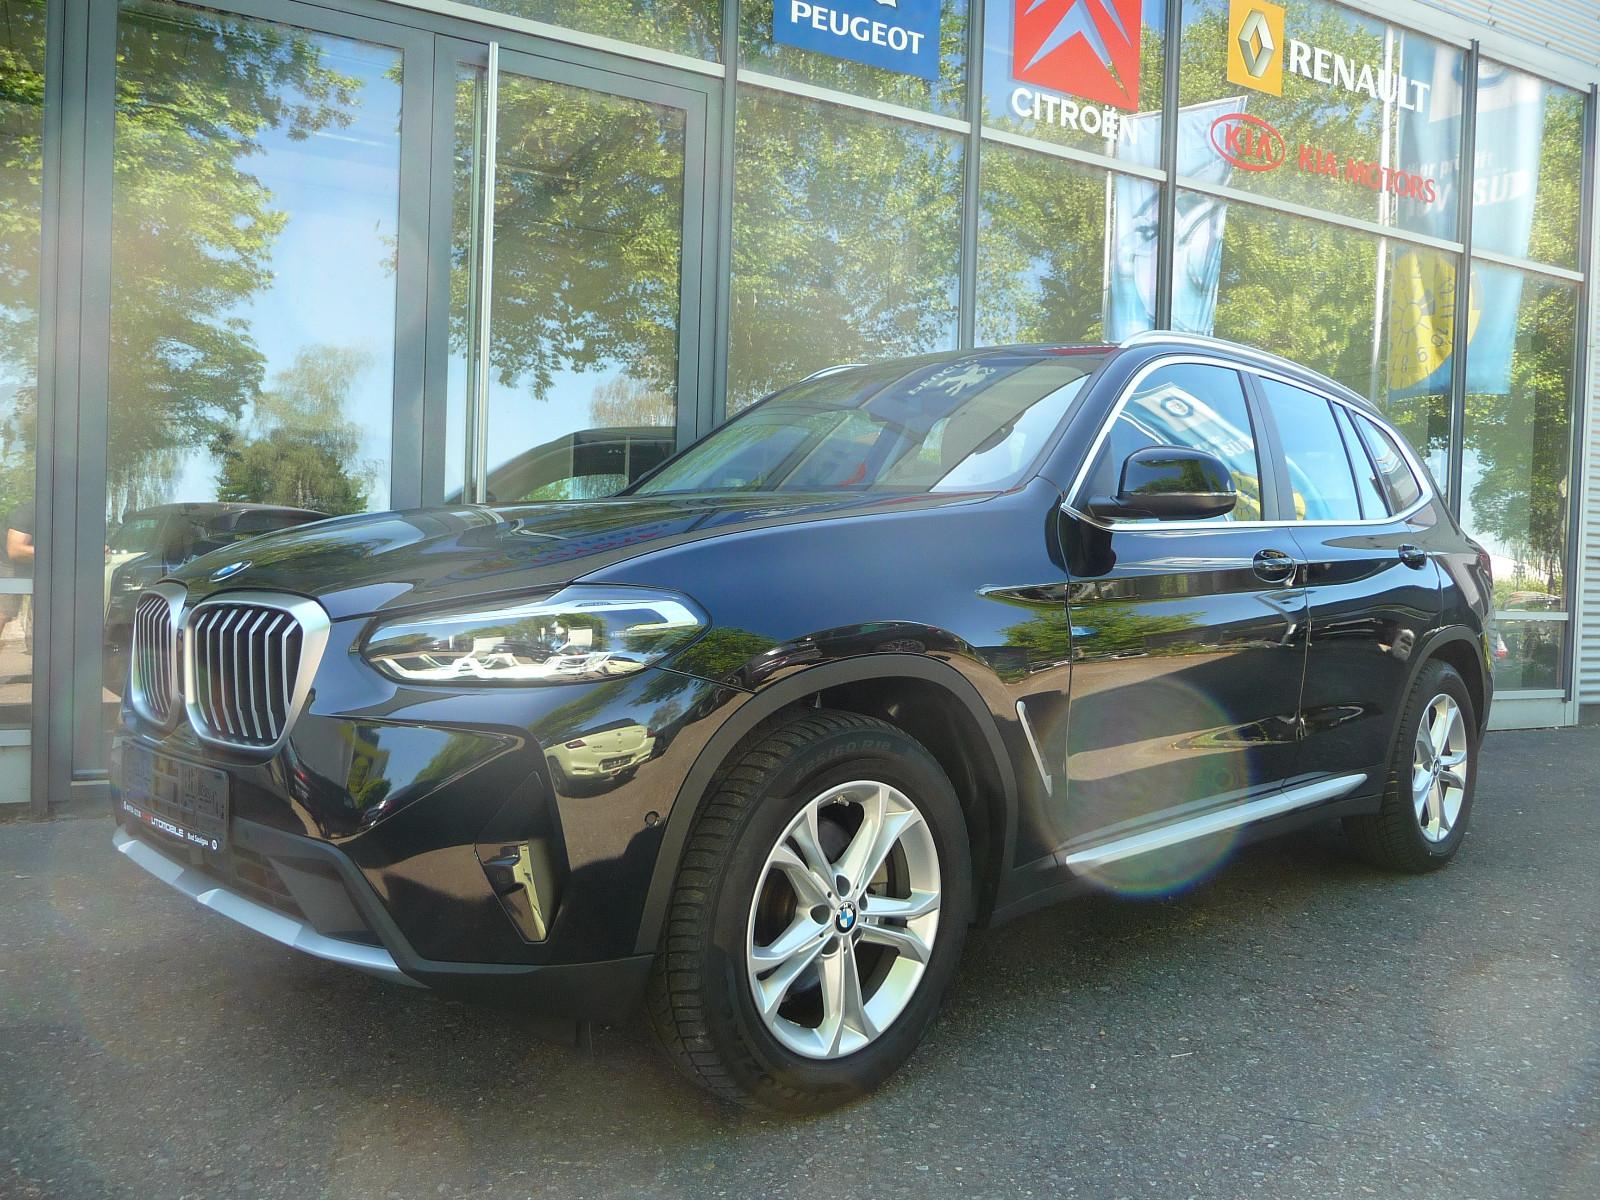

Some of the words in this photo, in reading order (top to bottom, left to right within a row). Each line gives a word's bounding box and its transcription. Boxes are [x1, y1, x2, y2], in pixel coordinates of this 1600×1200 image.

[790, 0, 925, 55] PEUGEOT
[1289, 39, 1430, 113] RENAULT
[1011, 87, 1138, 145] CITROËN
[1224, 123, 1273, 161] KIA
[1299, 143, 1338, 177] KIA
[1344, 156, 1437, 203] MOTORS
